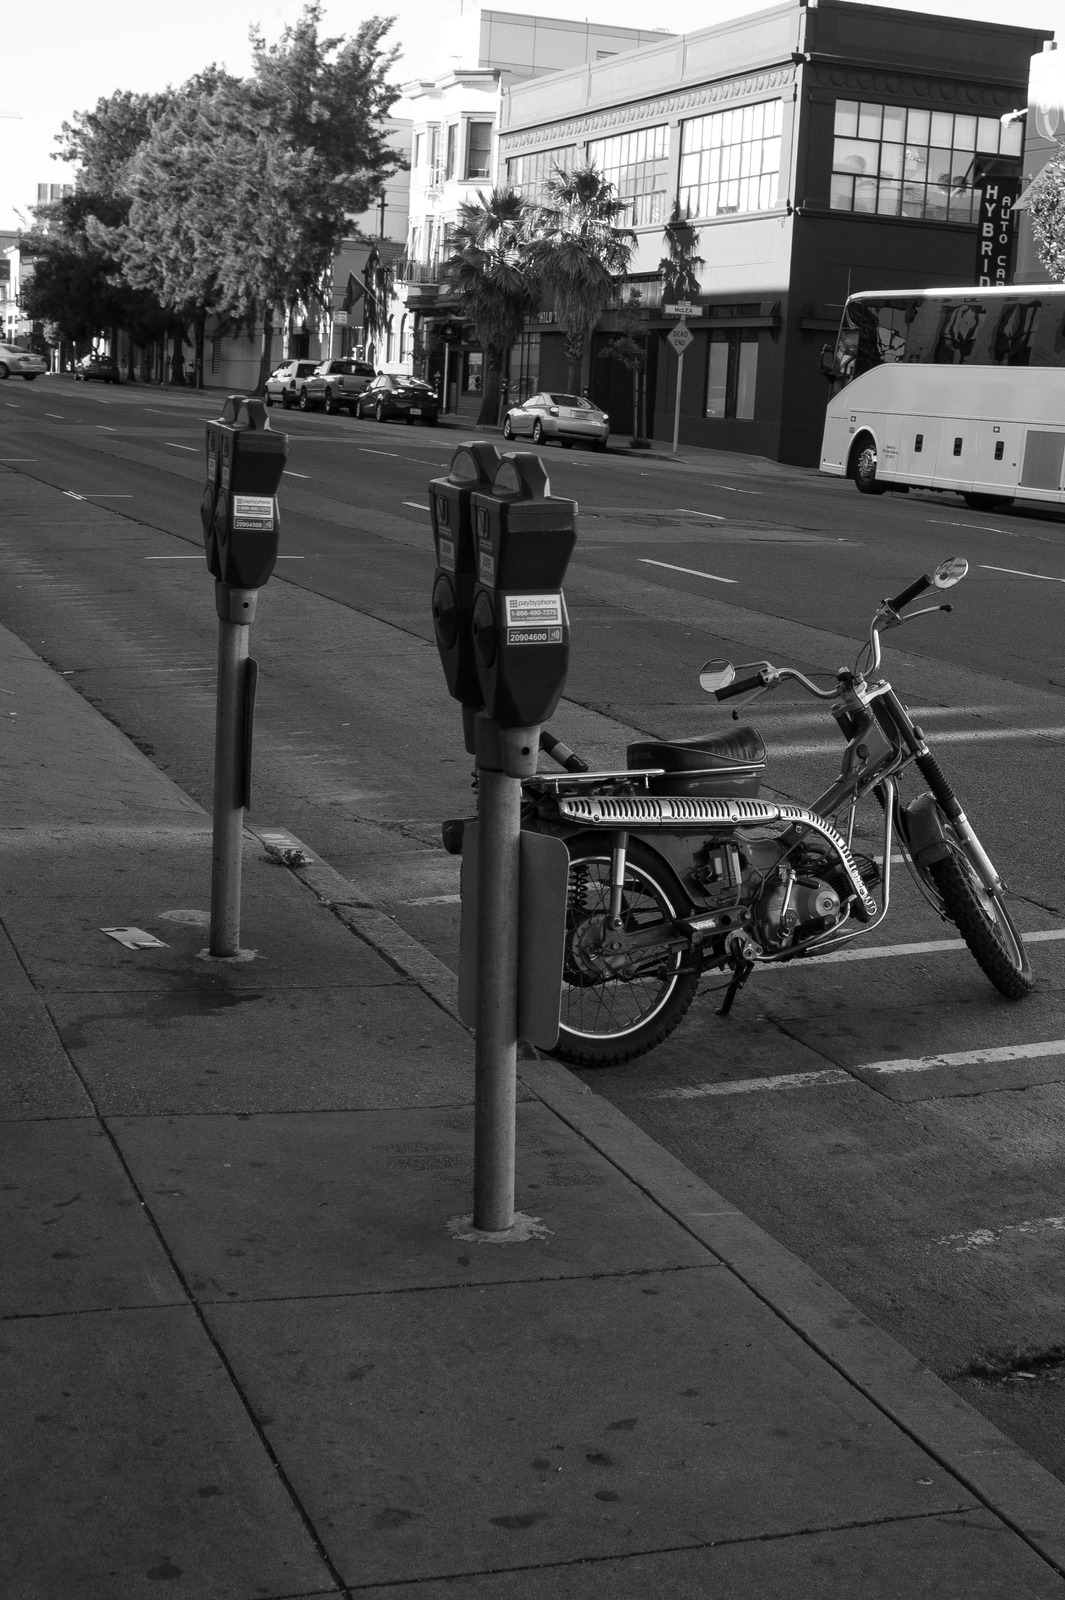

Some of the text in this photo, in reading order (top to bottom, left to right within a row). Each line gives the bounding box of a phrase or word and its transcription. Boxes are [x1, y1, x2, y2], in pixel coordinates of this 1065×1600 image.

[999, 196, 1011, 244] AUTO
[979, 184, 999, 287] HYBRID
[672, 330, 689, 338] DEAD
[518, 598, 558, 607] paybyphone
[510, 633, 547, 642] 20904600
